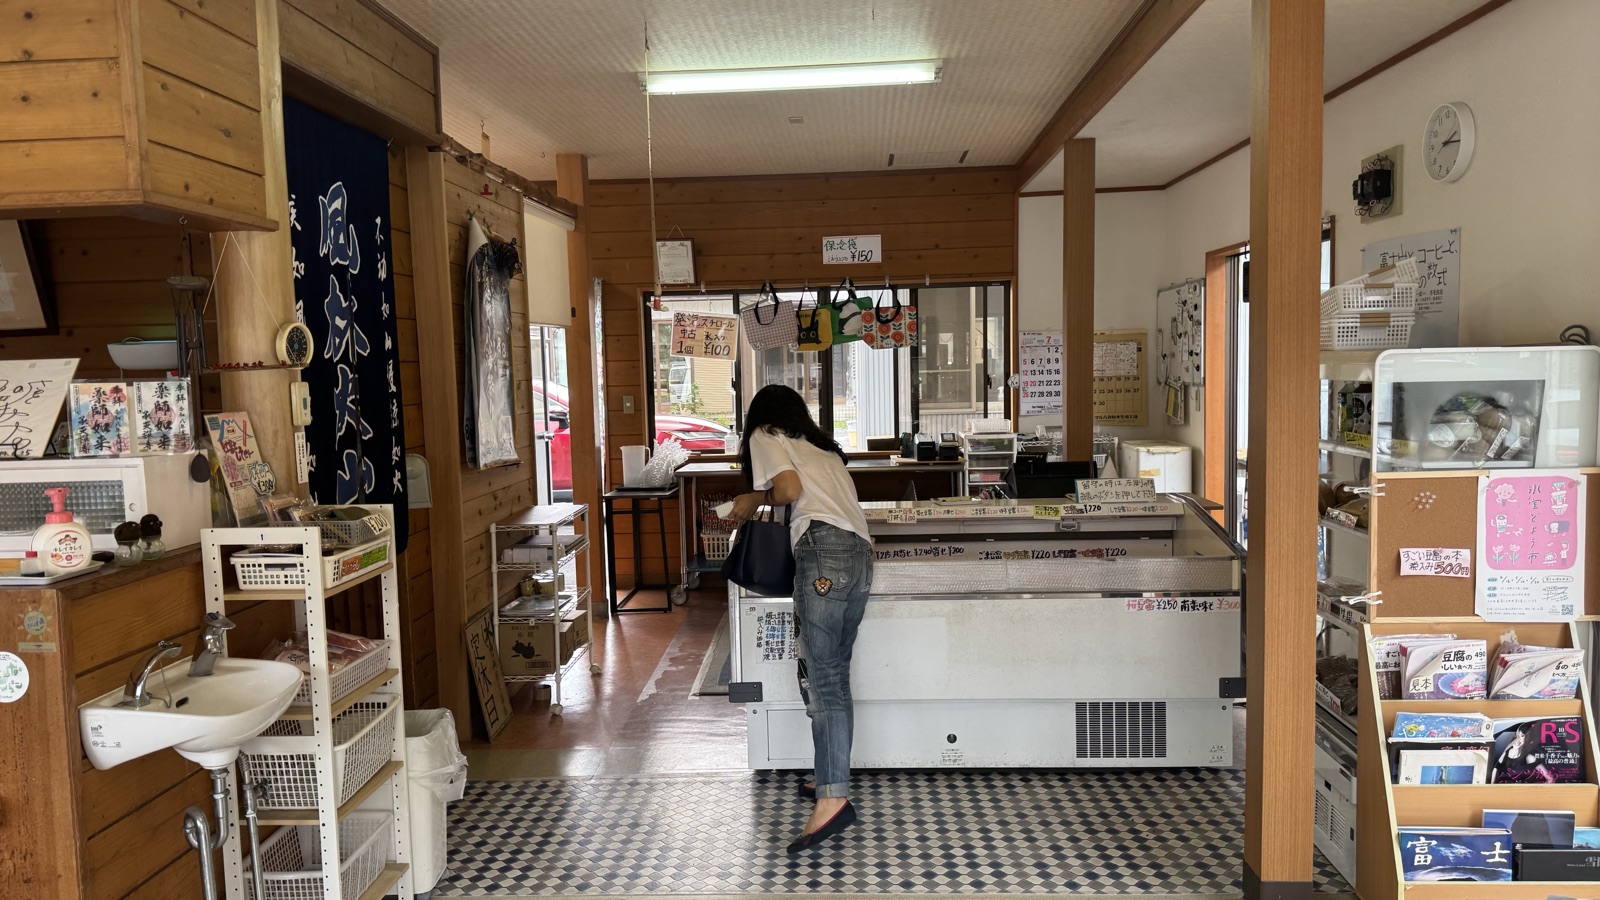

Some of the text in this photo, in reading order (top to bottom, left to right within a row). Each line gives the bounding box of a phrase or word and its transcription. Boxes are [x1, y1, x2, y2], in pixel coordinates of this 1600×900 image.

[850, 250, 874, 262] ¥150
[680, 329, 697, 339] 中古
[676, 341, 731, 356] 1個 ¥100
[1084, 504, 1101, 514] ¥220
[364, 514, 388, 533] ¥200
[947, 545, 964, 556] ¥200
[1031, 550, 1050, 559] ¥220
[1105, 547, 1127, 557] ¥220
[1434, 561, 1470, 576] 500円
[1156, 598, 1178, 610] ¥250
[1216, 598, 1240, 610] ¥300
[1442, 650, 1473, 662] 豆腐の
[471, 632, 500, 728] 定休日
[1410, 677, 1432, 693] 見本
